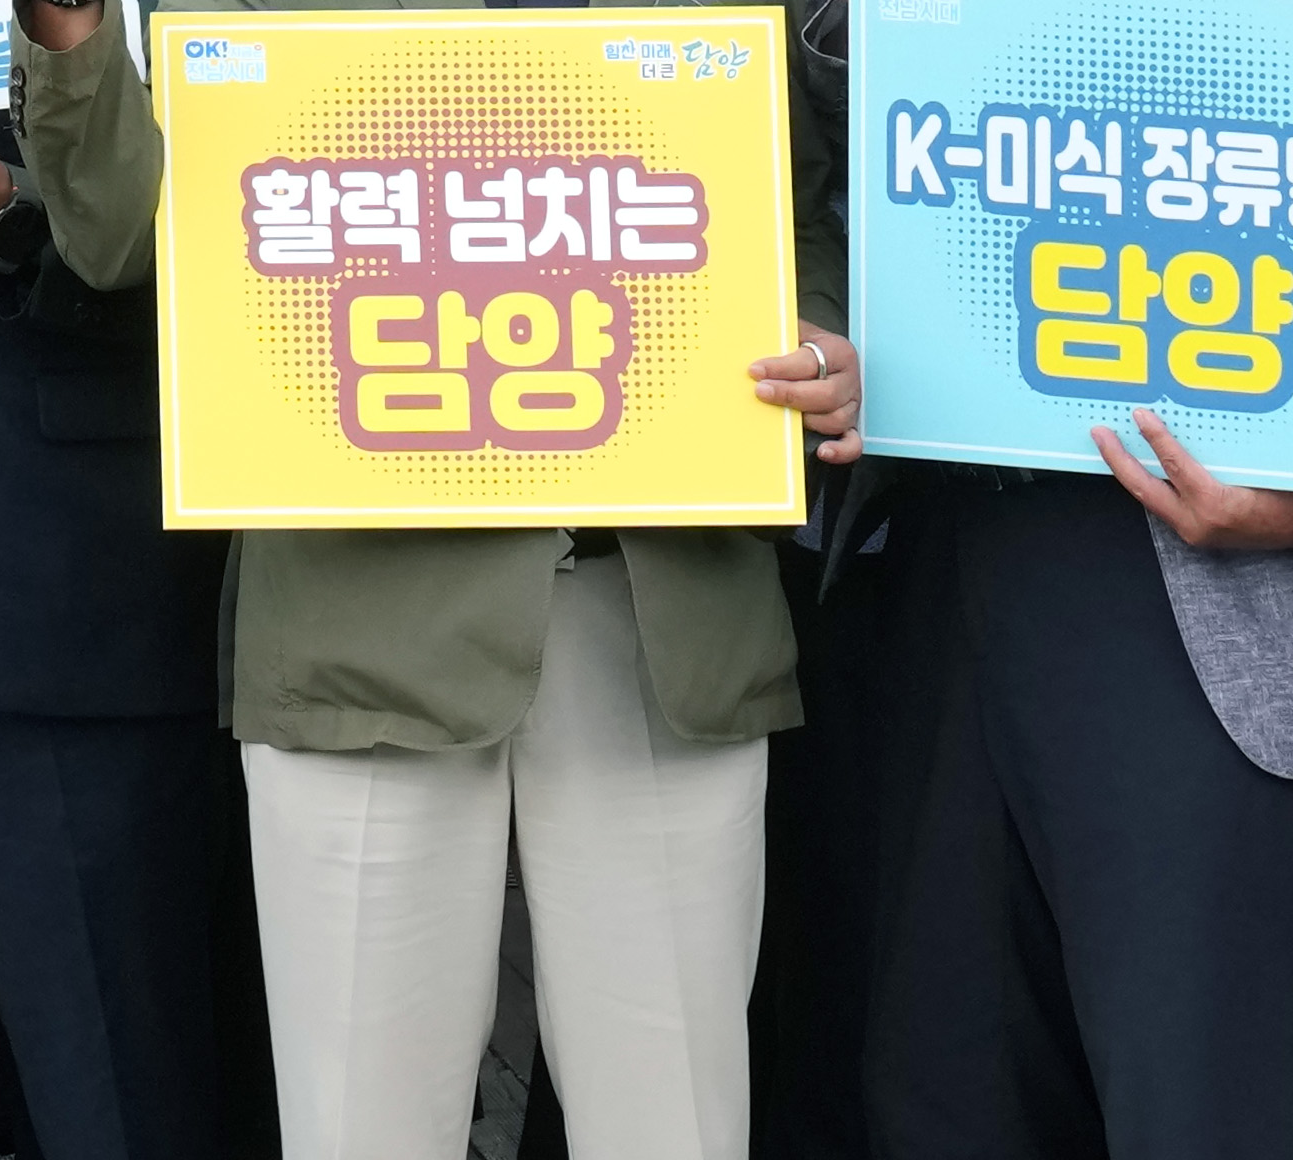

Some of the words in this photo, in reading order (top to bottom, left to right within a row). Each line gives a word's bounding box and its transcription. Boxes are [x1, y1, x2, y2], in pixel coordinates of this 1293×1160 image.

[186, 40, 229, 59] OK!
[605, 40, 637, 60] 힘찬
[641, 43, 677, 60] 미래,
[682, 40, 750, 80] 담양
[185, 60, 266, 82] 전남시대
[641, 63, 656, 79] 더
[660, 63, 675, 79] 큰
[895, 110, 1123, 215] K-미식
[1142, 126, 1293, 228] 장류
[250, 166, 422, 265] 활력
[443, 166, 700, 263] 넘치는
[1030, 241, 1293, 396] 담양
[347, 288, 616, 432] 담양
